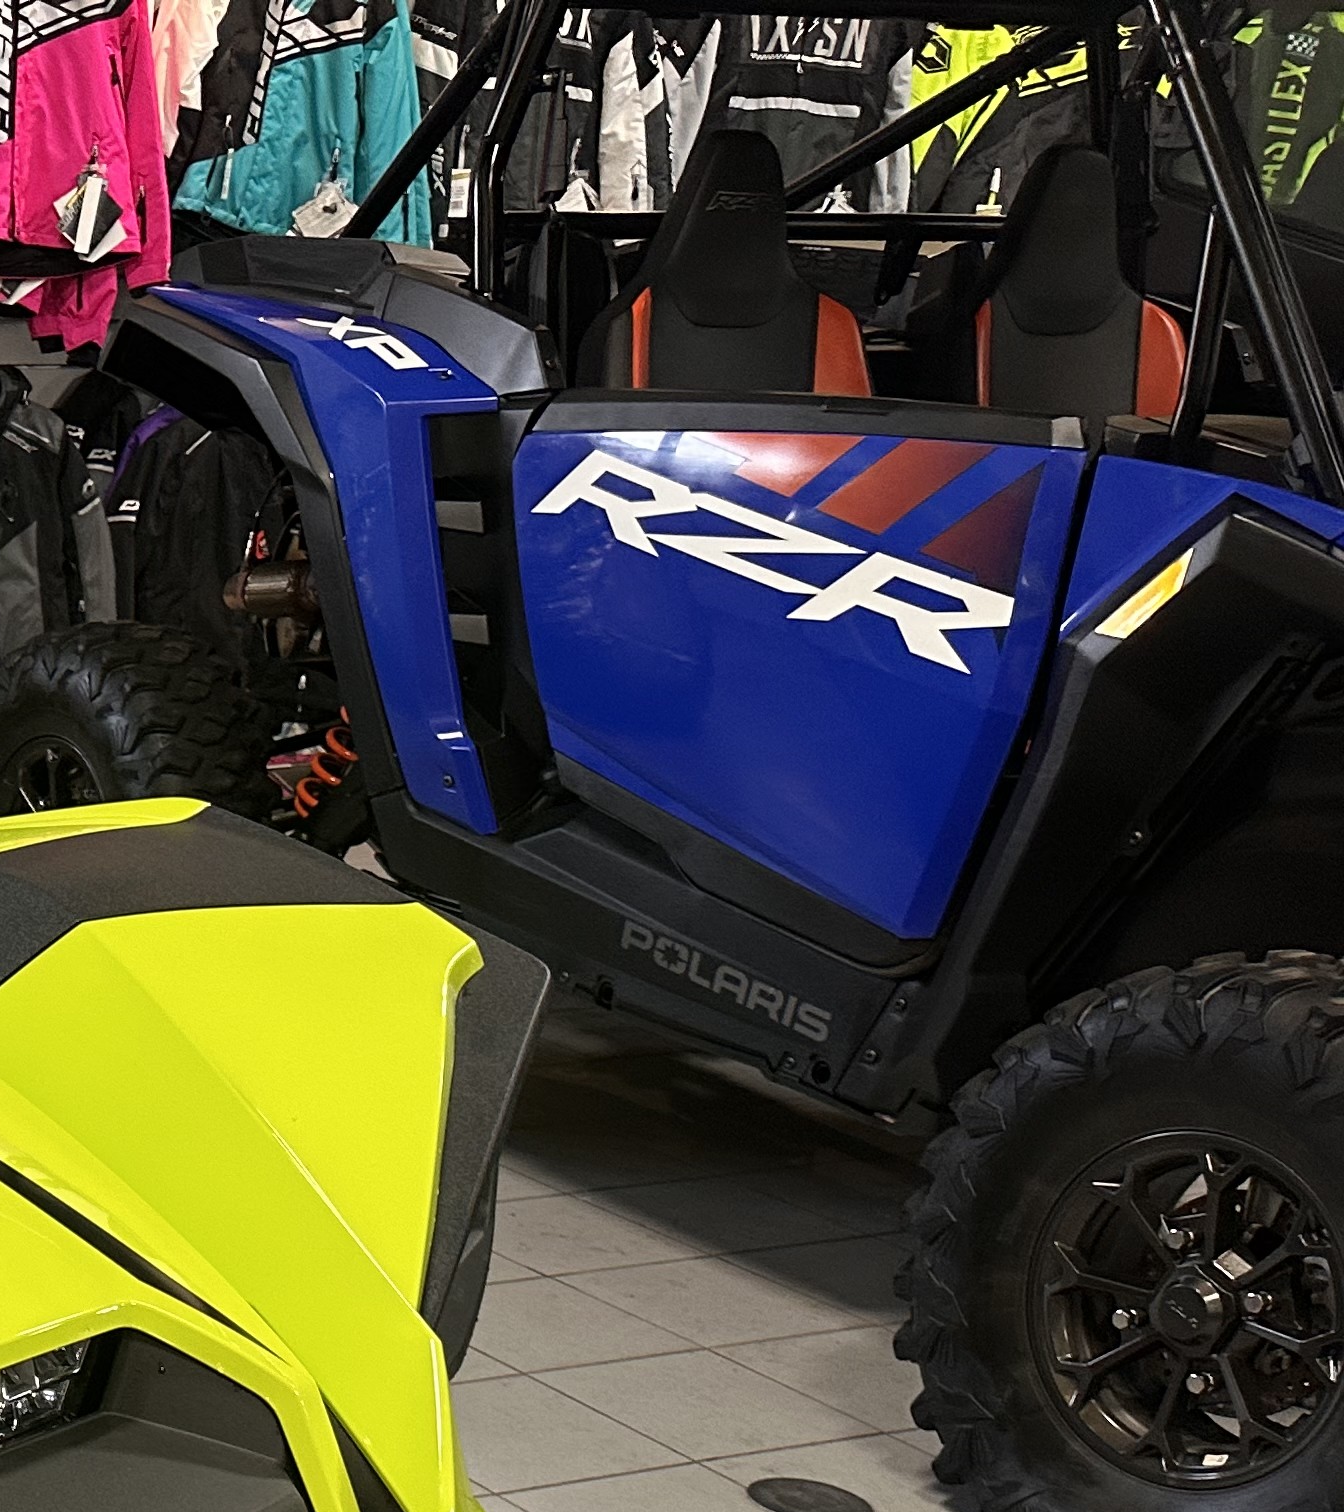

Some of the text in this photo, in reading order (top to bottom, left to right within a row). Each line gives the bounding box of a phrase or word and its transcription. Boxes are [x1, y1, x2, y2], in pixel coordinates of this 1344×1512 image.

[295, 306, 430, 371] XP
[531, 449, 1016, 675] RZR
[620, 919, 833, 1034] POLARIS
